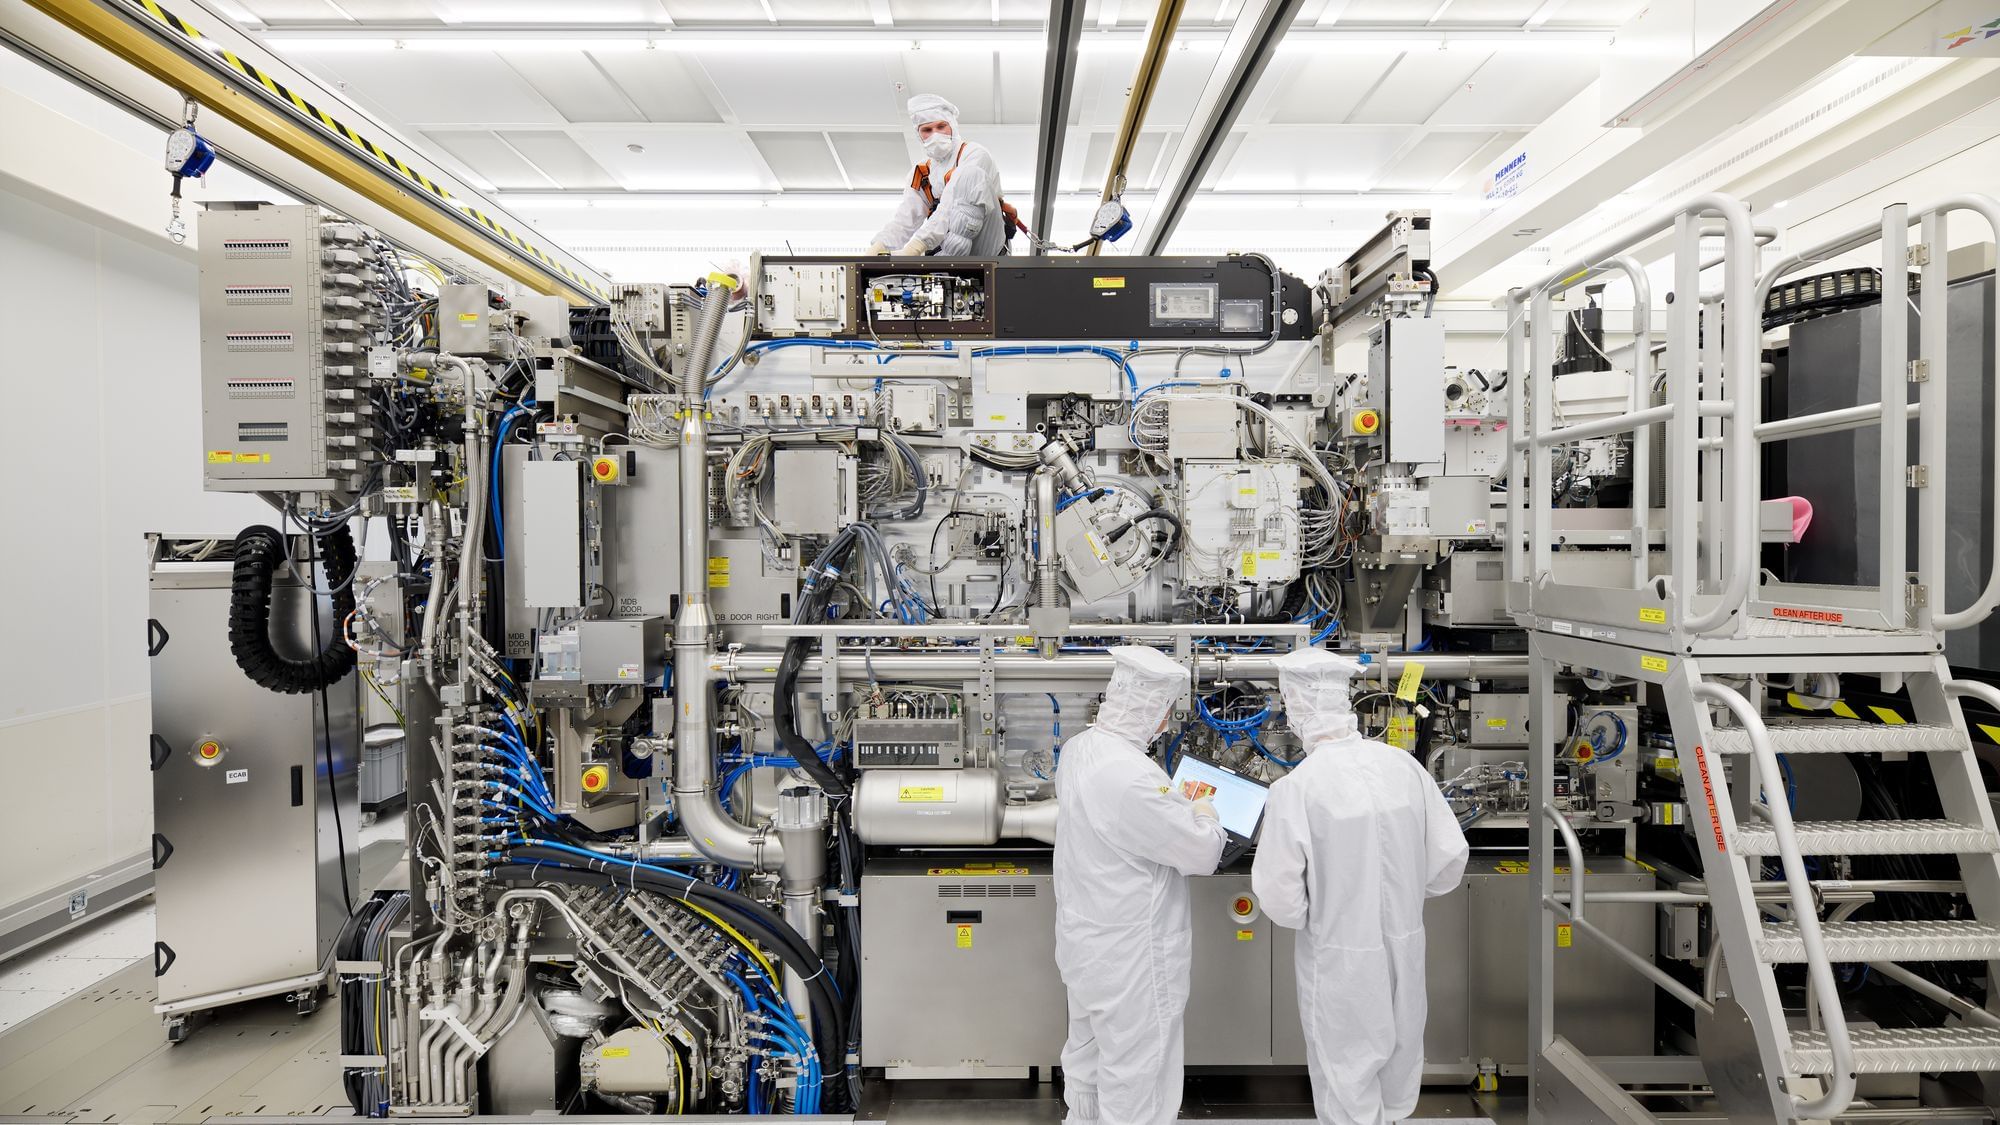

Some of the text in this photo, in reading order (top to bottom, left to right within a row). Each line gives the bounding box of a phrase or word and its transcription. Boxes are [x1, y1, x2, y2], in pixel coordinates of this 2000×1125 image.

[1495, 152, 1526, 182] MENNENS
[1773, 607, 1843, 622] CLEAN AFTER USE
[1695, 746, 1726, 851] CLEAN AFTER USE
